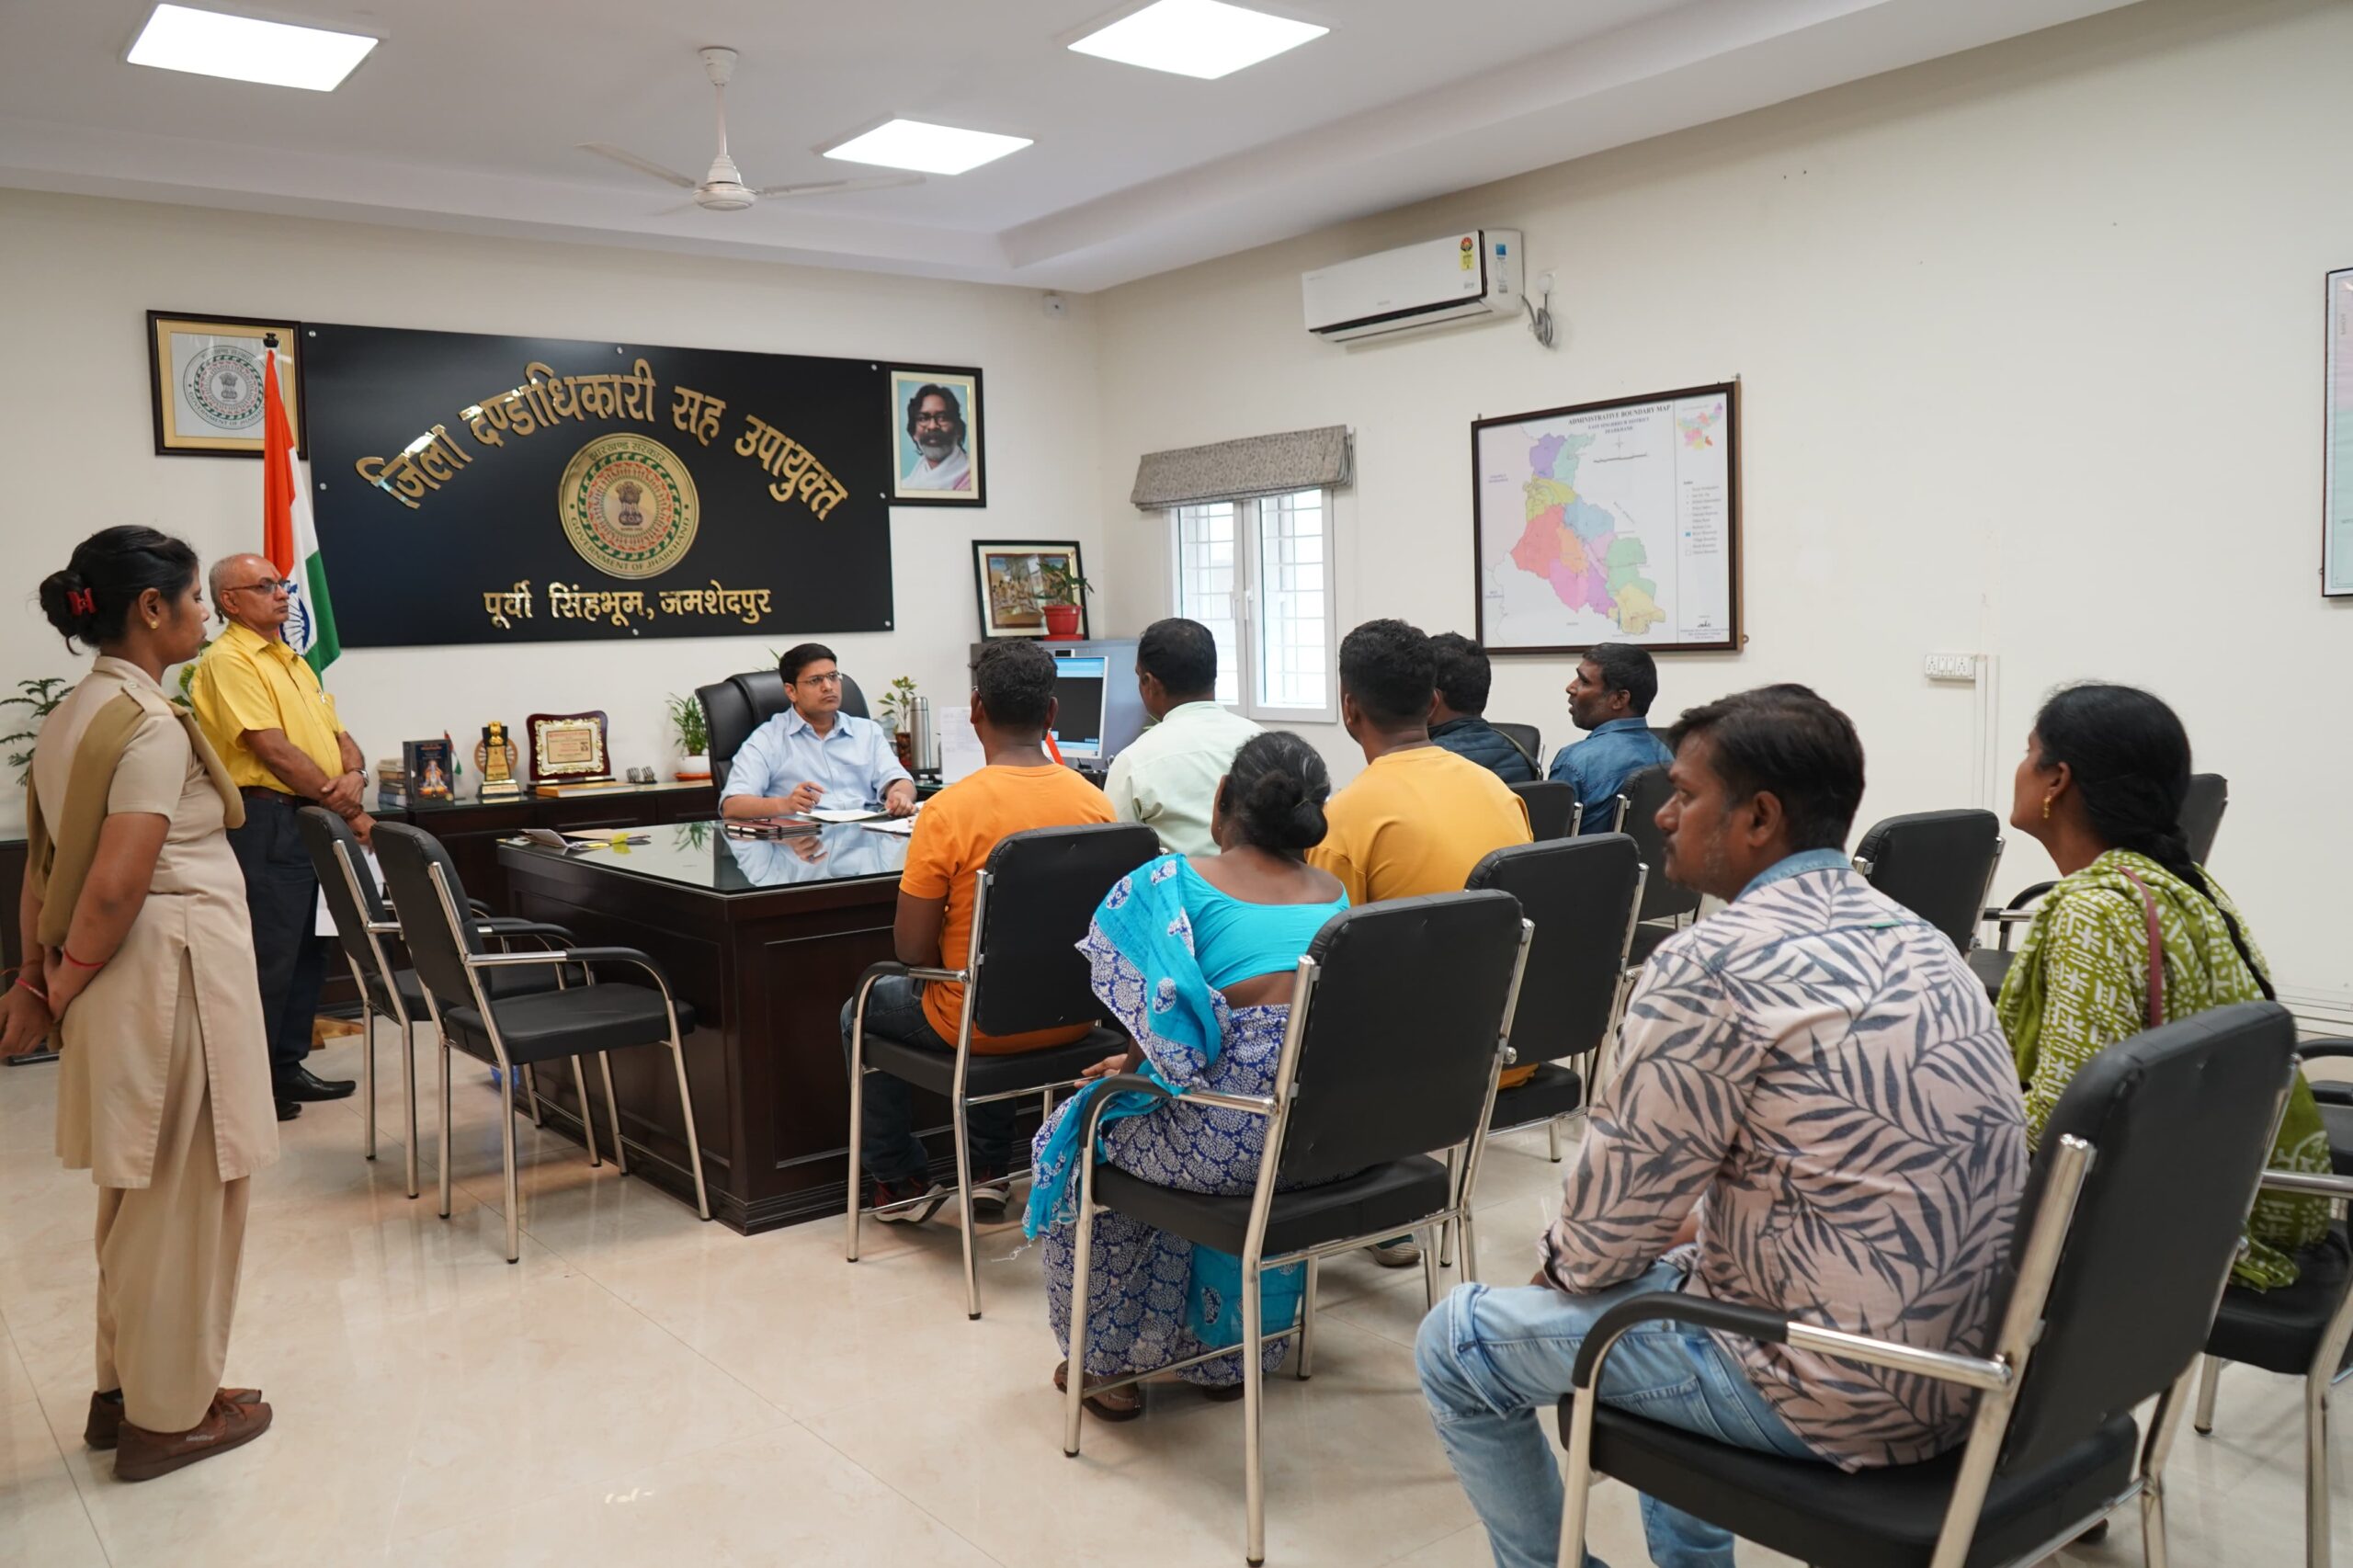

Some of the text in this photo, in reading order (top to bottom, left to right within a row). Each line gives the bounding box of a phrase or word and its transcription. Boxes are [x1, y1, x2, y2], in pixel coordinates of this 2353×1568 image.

[356, 358, 848, 521] जिला दण्डाधिकारी सह उपायुक्त
[1568, 412, 1619, 425] ADMINISTRATIVE
[1620, 407, 1654, 417] BOUNDARY
[588, 441, 666, 461] झारखण्ड सरकार
[571, 517, 689, 571] GOVERNMENT OF JHARKHAND
[483, 579, 772, 630] पूर्वी सिंहभूम, जमशेदपुर
